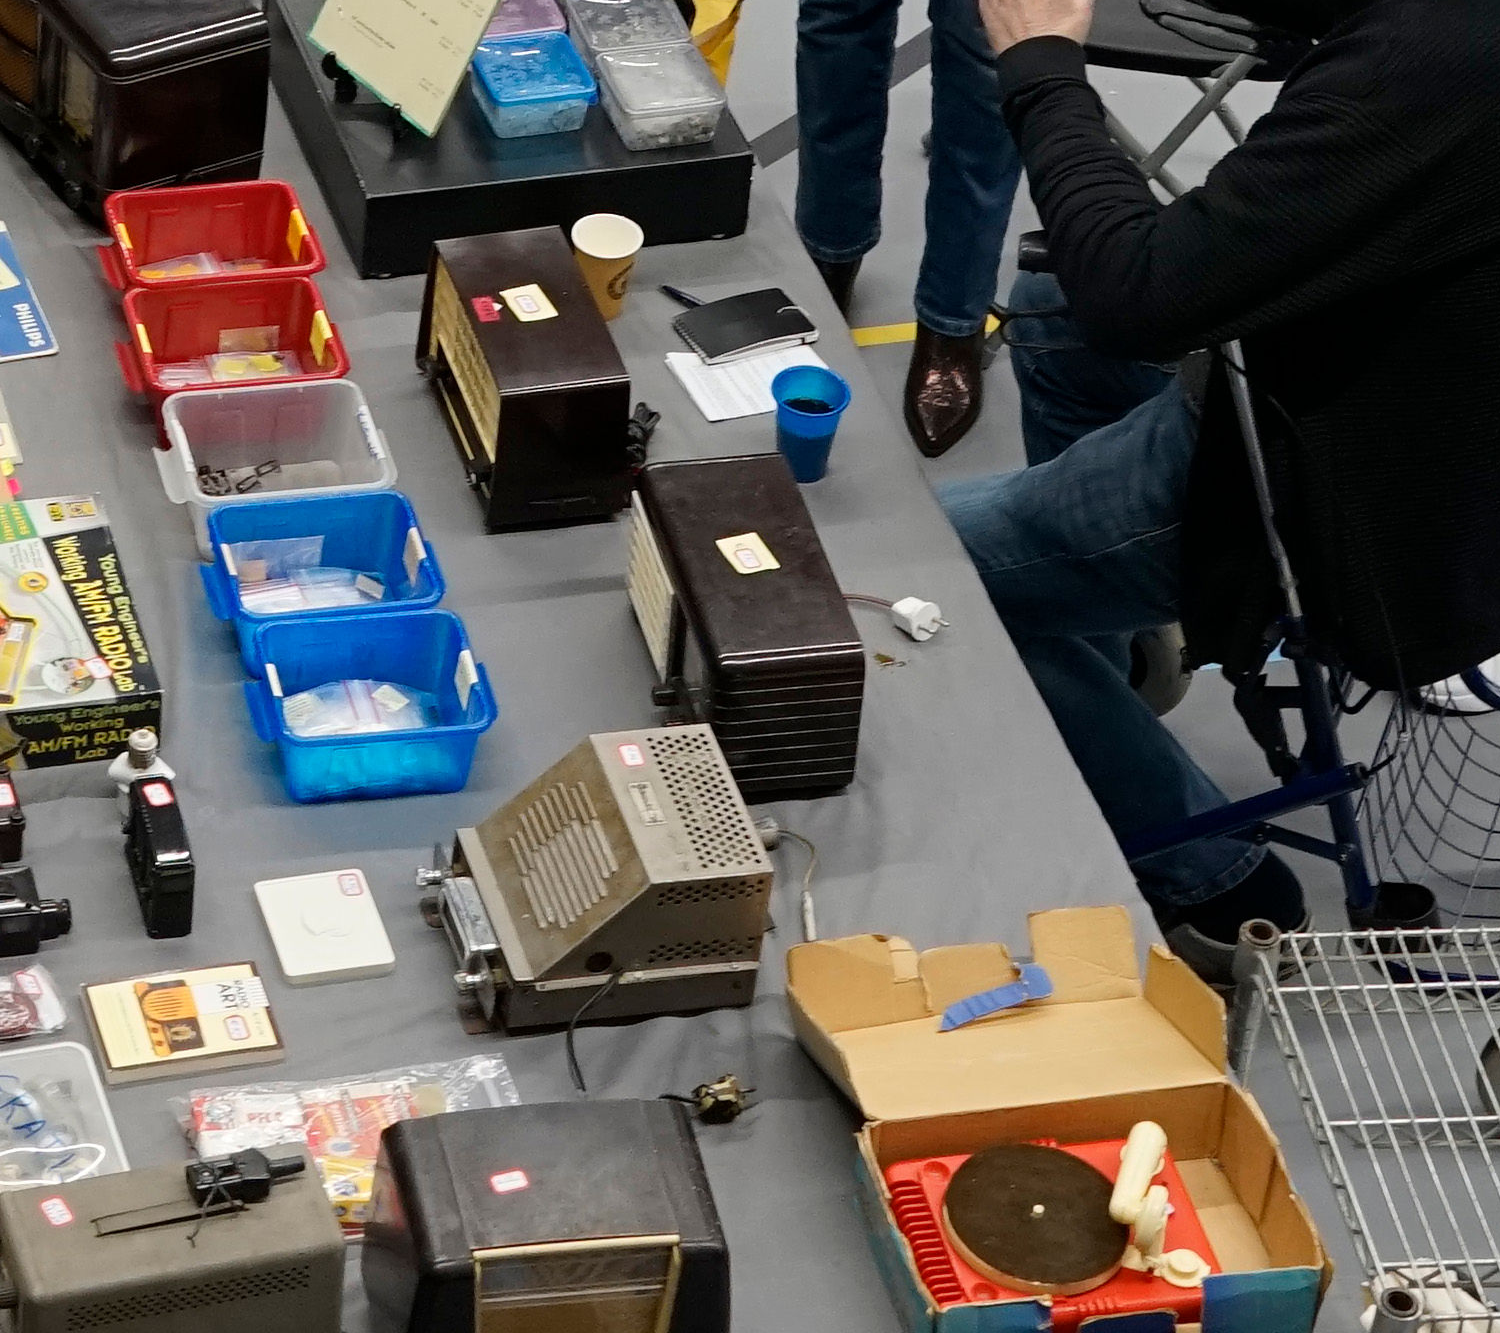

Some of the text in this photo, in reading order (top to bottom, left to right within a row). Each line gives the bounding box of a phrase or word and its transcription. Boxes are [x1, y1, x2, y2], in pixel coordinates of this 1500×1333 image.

[12, 302, 46, 348] PHILIPS
[52, 535, 88, 582] Working
[70, 579, 117, 631] AM/FM
[98, 552, 149, 665] Young Engineer's
[91, 625, 134, 675] RADIO
[112, 671, 139, 693] Lab
[14, 699, 161, 726] Young Engineer's
[59, 716, 125, 733] Working
[26, 725, 156, 756] AM/FM RAD
[74, 747, 108, 761] Lab
[216, 982, 237, 1012] ART
[231, 980, 250, 1011] RADIO
